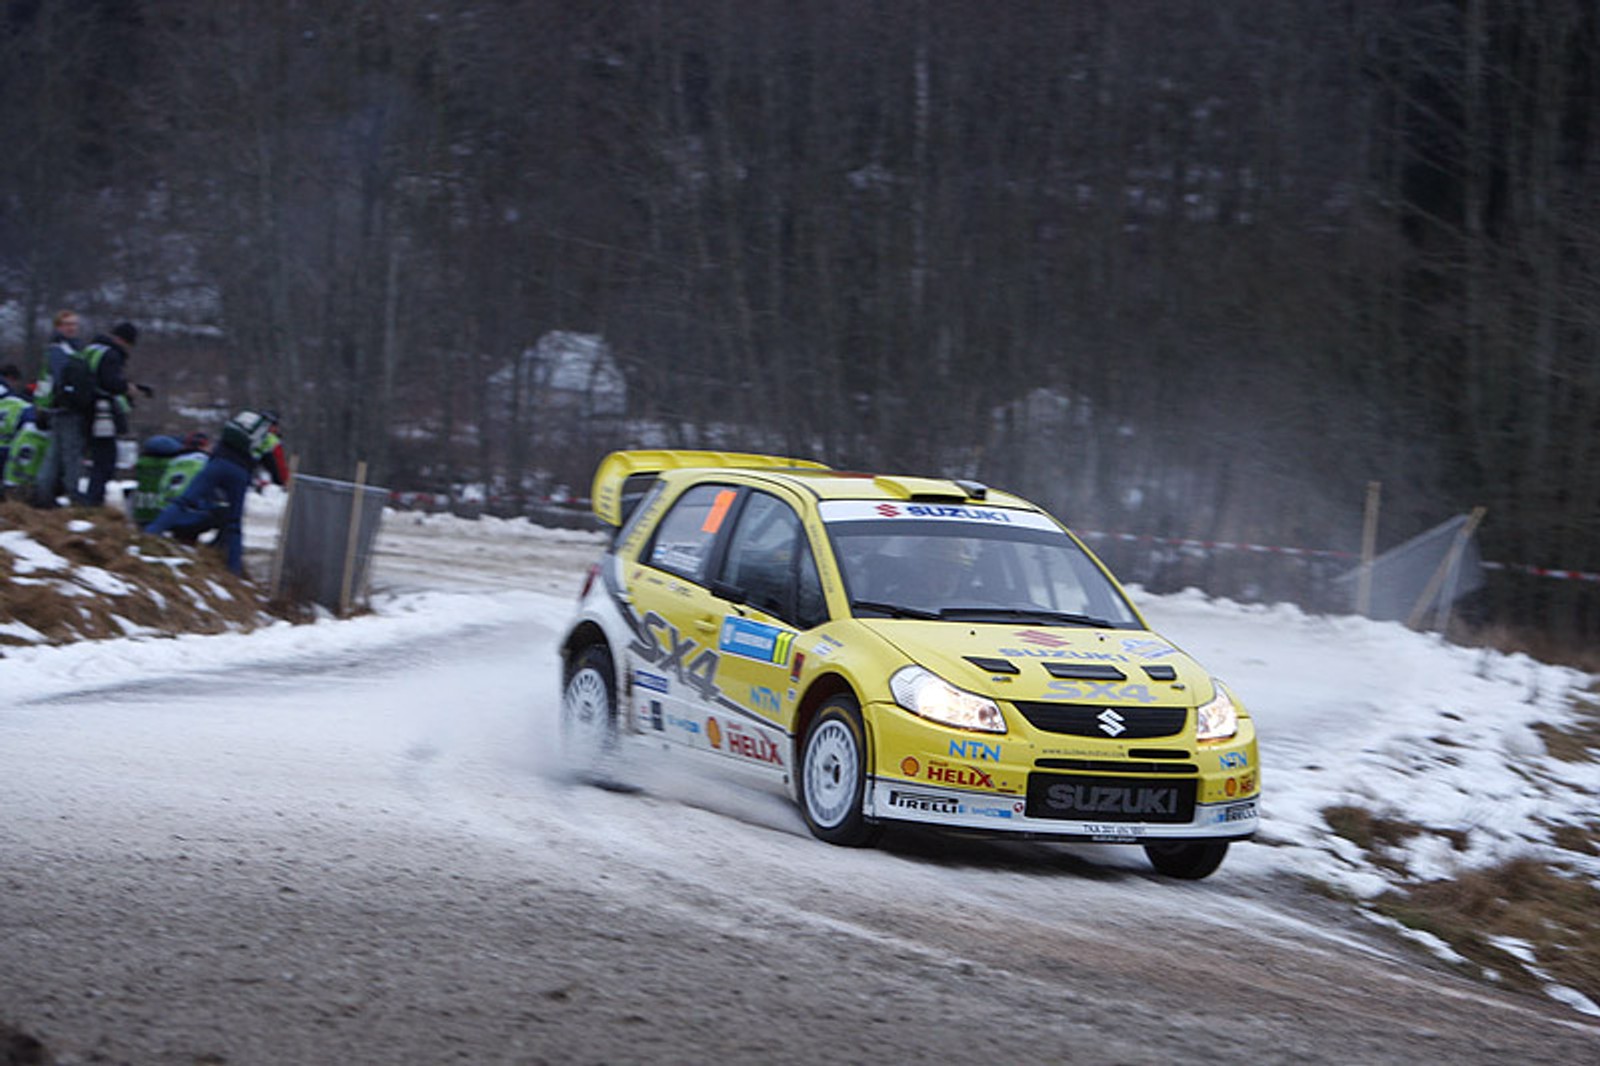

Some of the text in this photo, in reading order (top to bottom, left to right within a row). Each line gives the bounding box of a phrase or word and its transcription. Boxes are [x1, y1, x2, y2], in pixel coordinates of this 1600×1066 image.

[908, 505, 1010, 522] SUZUKI
[628, 611, 721, 701] SX4
[998, 649, 1129, 662] SUZUKI
[750, 686, 781, 712] NTN
[1041, 681, 1157, 703] SX4
[727, 730, 783, 765] HELIX
[949, 739, 1001, 762] NTN
[927, 764, 994, 787] HELIX
[888, 790, 959, 813] PIRELLI
[1046, 784, 1178, 814] SUZUKI
